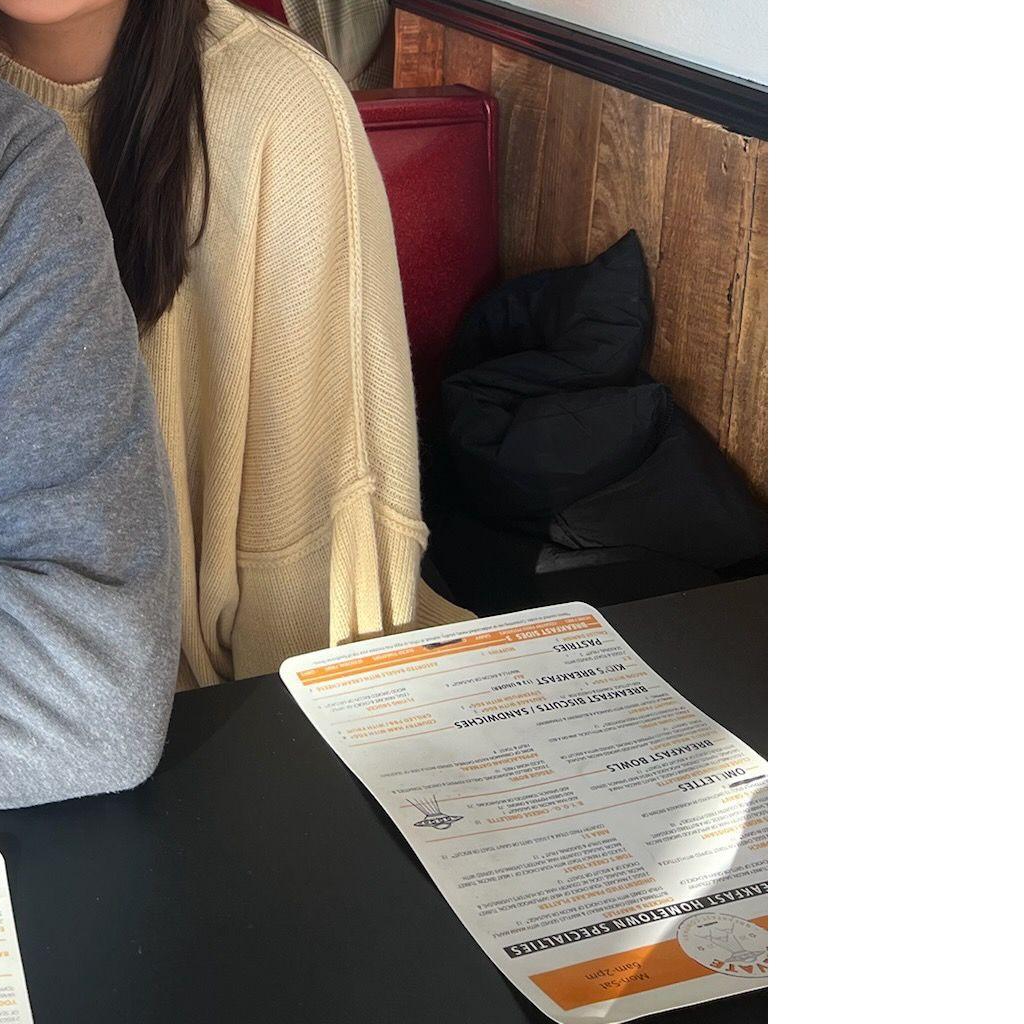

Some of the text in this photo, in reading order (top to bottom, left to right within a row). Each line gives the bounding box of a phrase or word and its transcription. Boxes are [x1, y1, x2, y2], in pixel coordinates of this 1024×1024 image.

[532, 668, 597, 684] BREAKFAST
[583, 686, 649, 702] BREAKFAST
[535, 697, 587, 712] BISCUITS
[451, 708, 531, 728] SANDWICHES
[646, 739, 714, 761] BREAKFAST
[604, 756, 649, 772] BOWLS
[610, 899, 705, 929] HOMETOWN
[508, 923, 611, 955] SPECIALTIES
[581, 960, 643, 981] 6am-2pm
[597, 971, 652, 991] Mon-Sat
